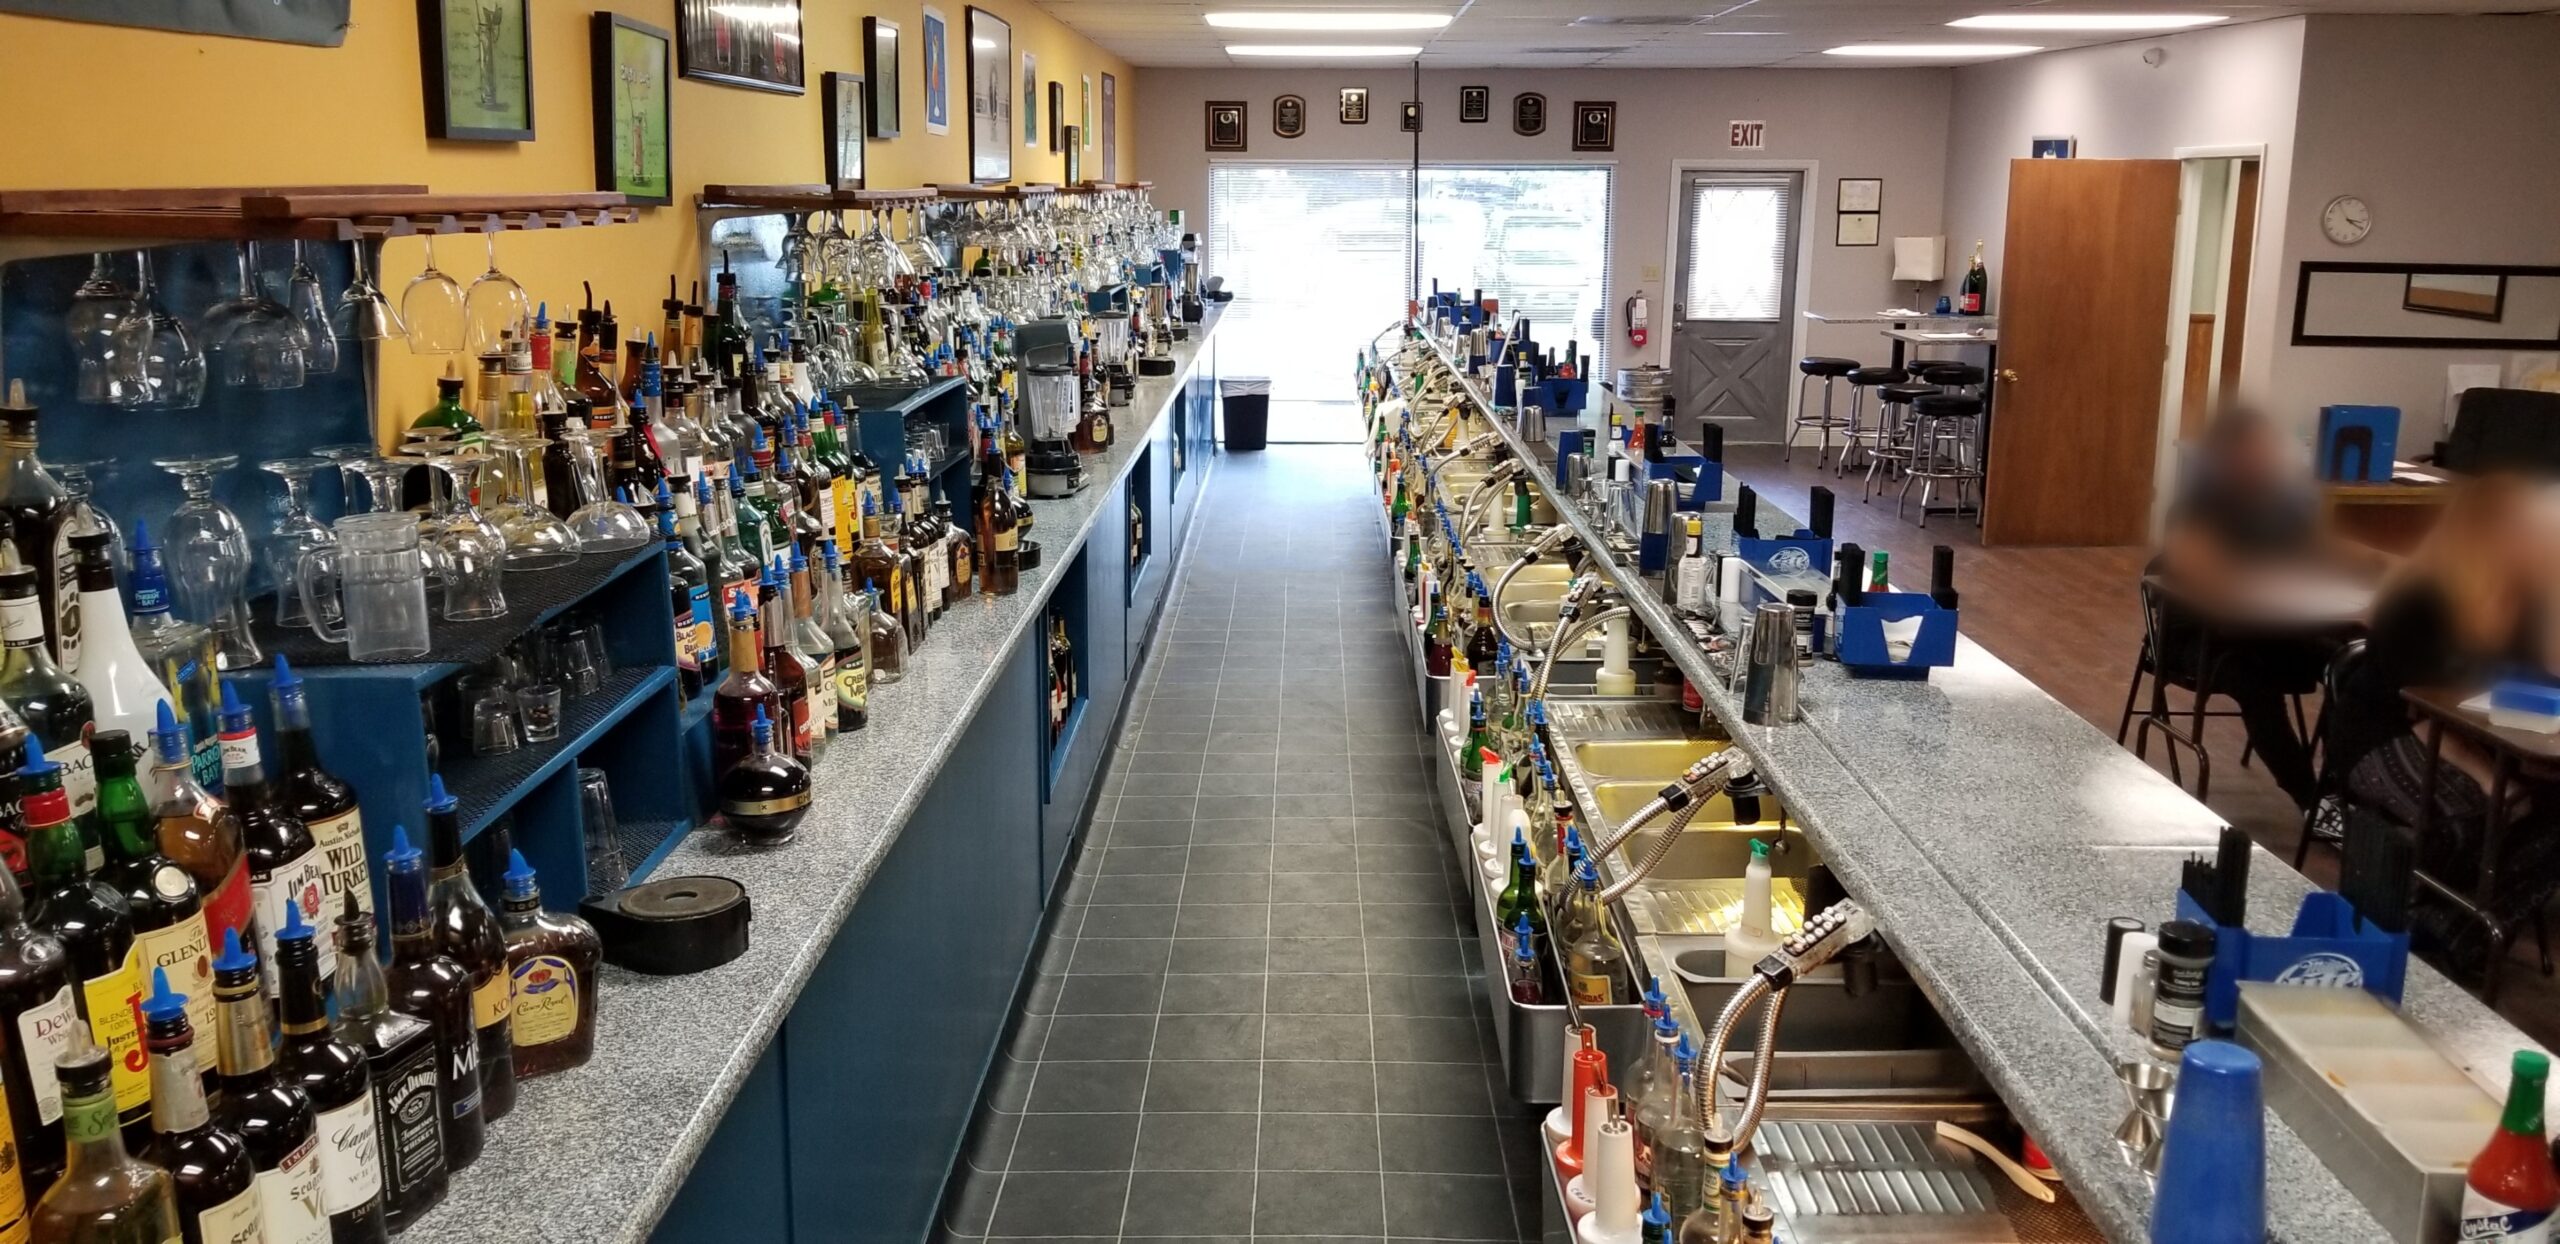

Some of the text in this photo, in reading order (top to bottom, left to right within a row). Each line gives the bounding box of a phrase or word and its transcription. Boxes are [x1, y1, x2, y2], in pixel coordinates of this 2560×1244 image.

[1731, 124, 1763, 147] EXIT
[202, 765, 219, 786] BAY
[319, 835, 343, 849] Austin
[326, 841, 362, 872] WILD
[516, 994, 568, 1016] Crown Royal
[125, 991, 149, 1072] J
[388, 1083, 410, 1115] JACK
[402, 1126, 435, 1153] WHISKEY
